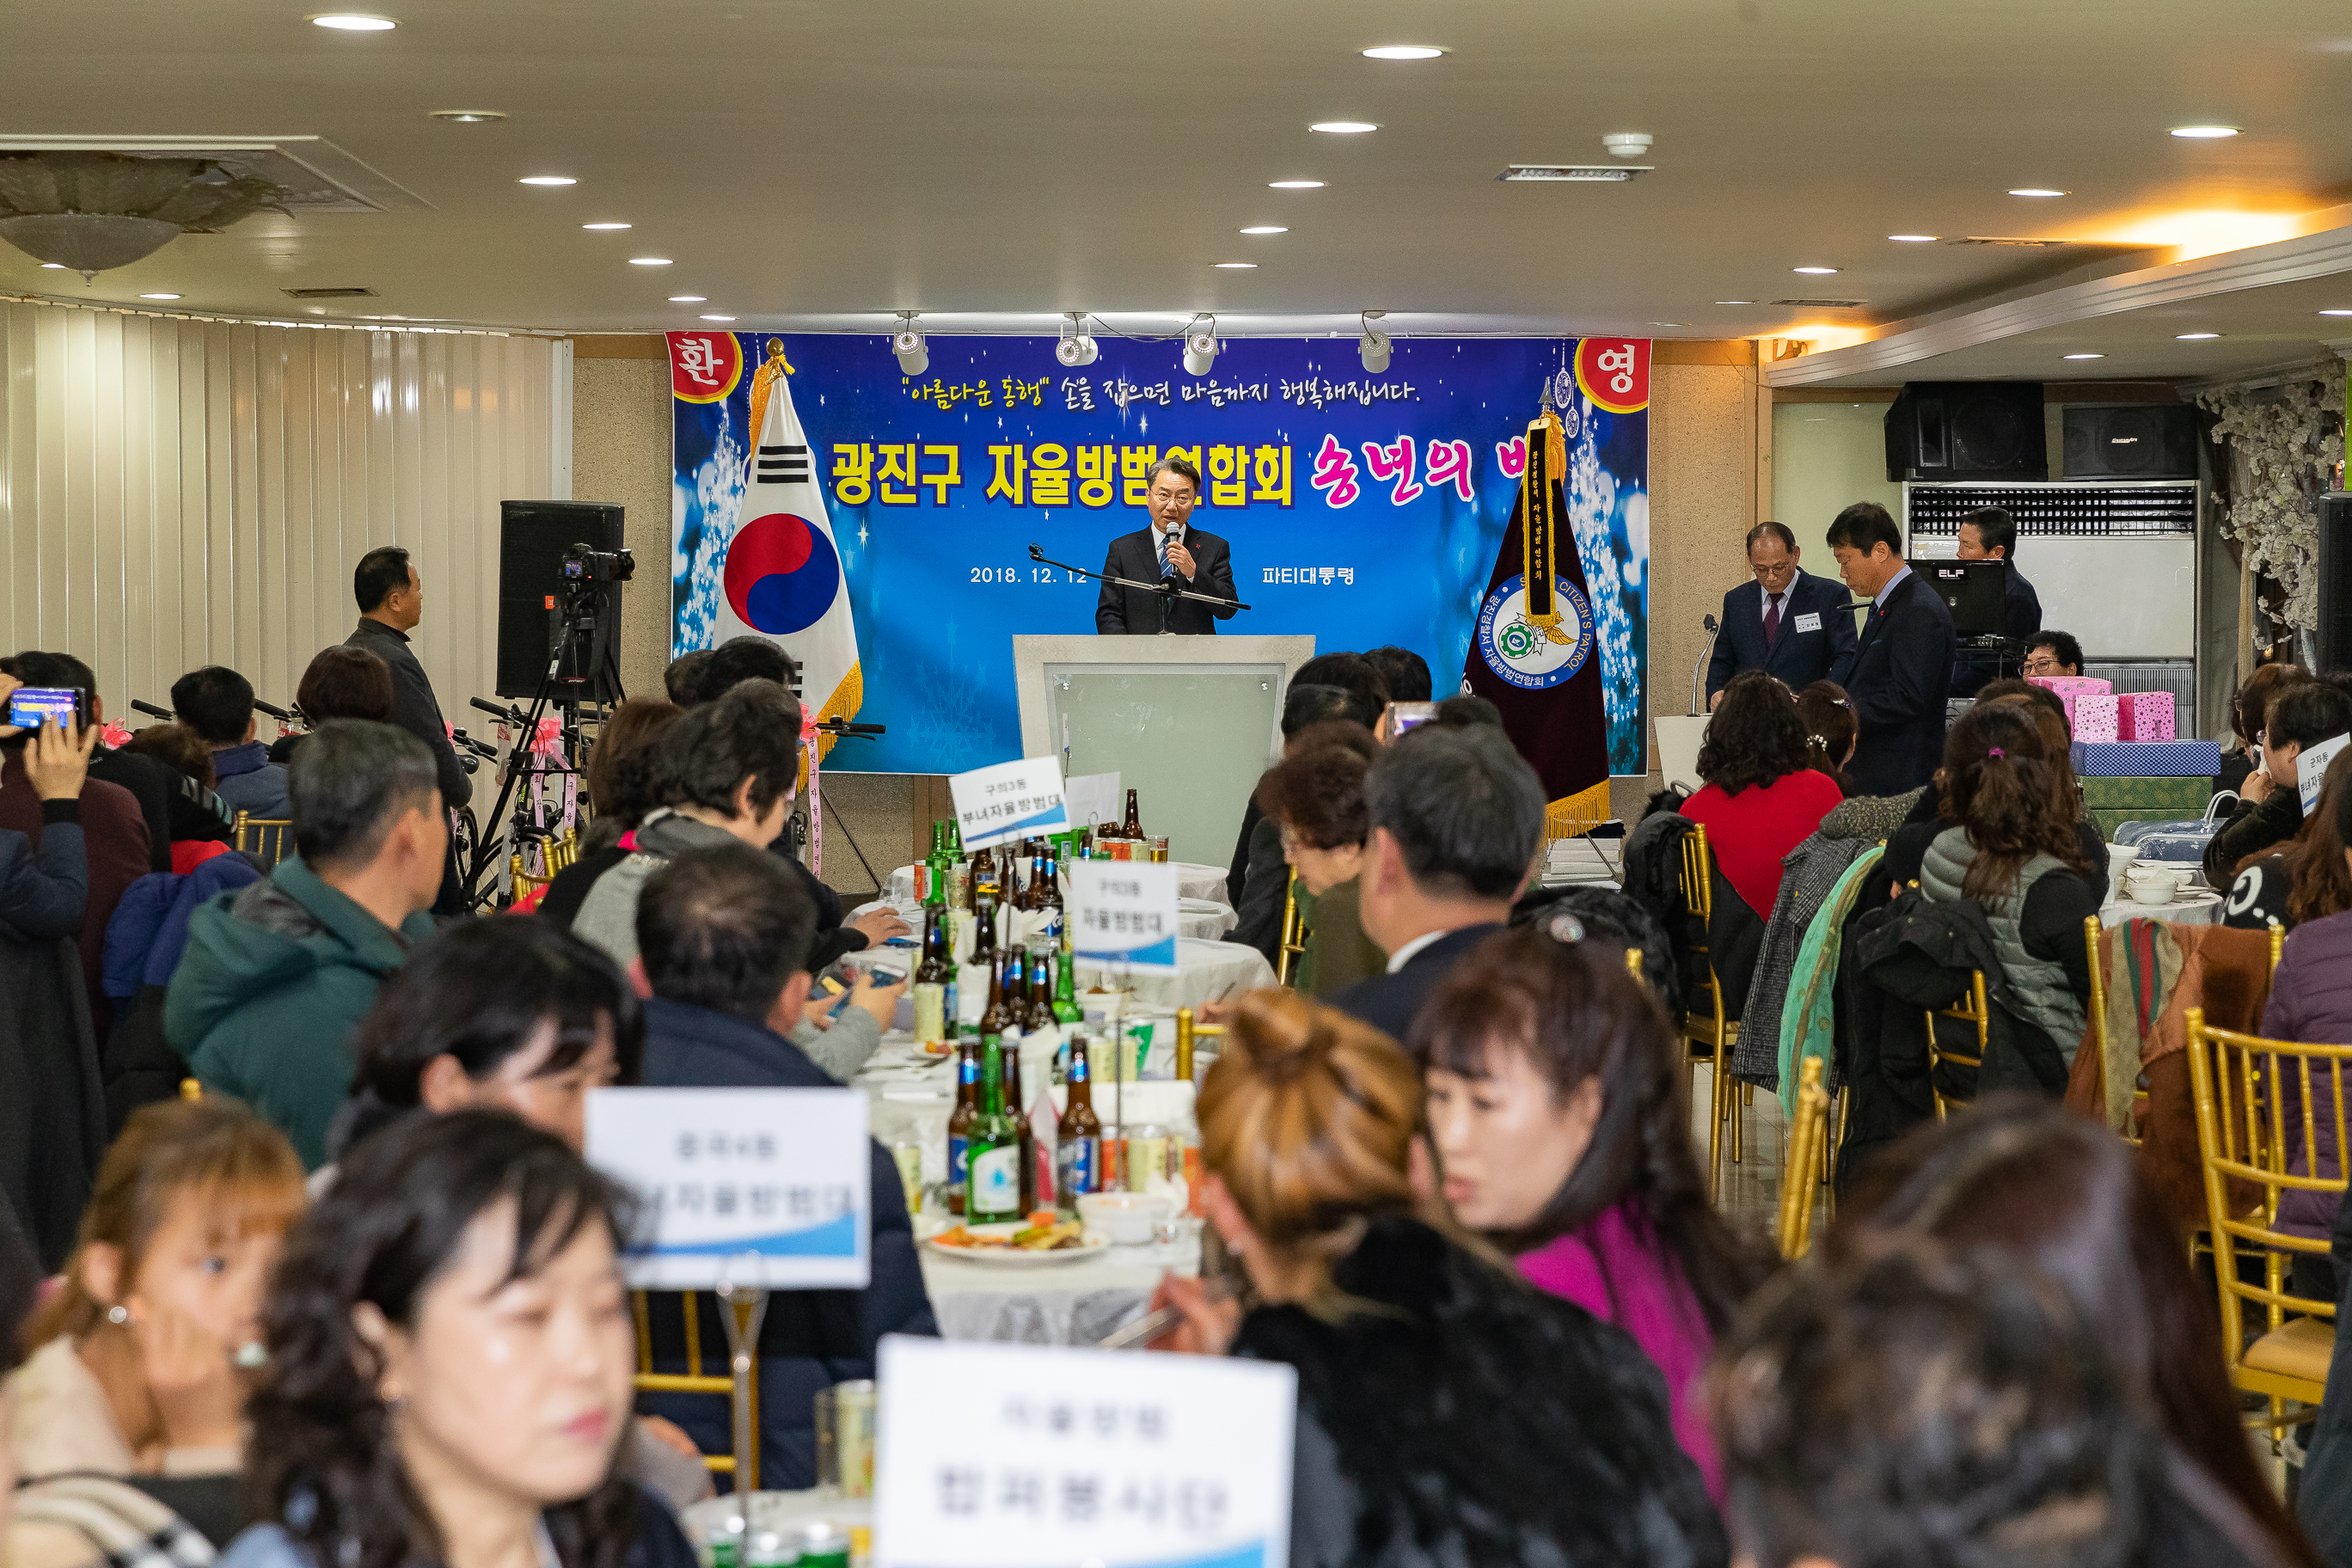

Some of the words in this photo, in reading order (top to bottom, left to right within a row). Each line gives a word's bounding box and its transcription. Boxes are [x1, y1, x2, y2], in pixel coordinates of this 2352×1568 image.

[678, 338, 723, 385] 환
[1597, 344, 1636, 393] 영
[1062, 377, 1095, 410] 손을
[1103, 378, 1170, 407] 잡으면
[1182, 379, 1268, 407] 마음까지
[1280, 377, 1420, 410] 행복해집니다.
[832, 443, 961, 505] 광진구
[1312, 432, 1475, 508] 송년의
[971, 567, 1021, 583] 2018.
[1032, 567, 1057, 583] 12.
[1262, 566, 1354, 585] 파티대통령
[1939, 569, 1964, 578] ELF
[1559, 581, 1592, 629] CITIZEN'S
[1485, 646, 1544, 687] 자율방범연합회
[1564, 633, 1591, 671] PATROL
[2310, 751, 2329, 769] 군자동
[985, 779, 1026, 797] 구의3동
[962, 793, 1062, 825] 부녀자율방범대
